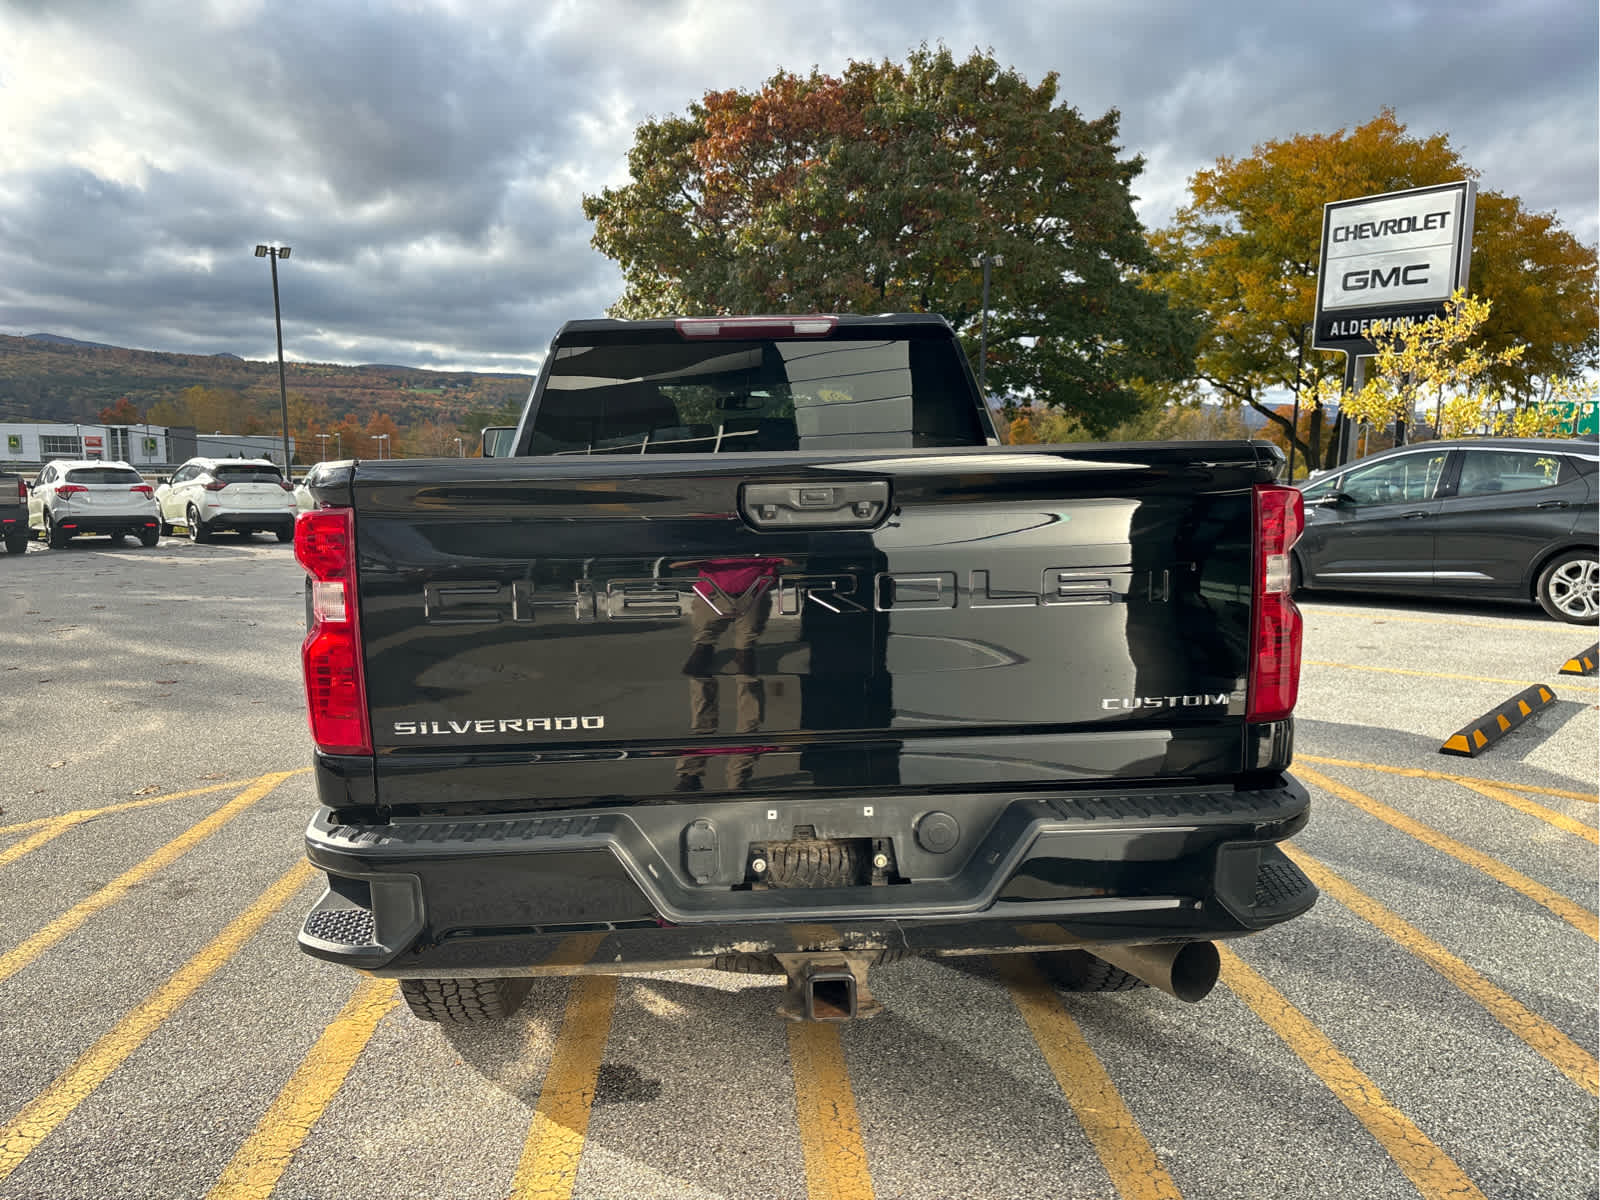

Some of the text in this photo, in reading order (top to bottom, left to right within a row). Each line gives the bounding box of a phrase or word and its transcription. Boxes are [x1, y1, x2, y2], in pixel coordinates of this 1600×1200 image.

[1333, 211, 1451, 243] CHEVROLET
[1342, 264, 1430, 291] GMC
[1101, 693, 1230, 710] CUSTOM
[394, 715, 605, 735] SILVERADO
